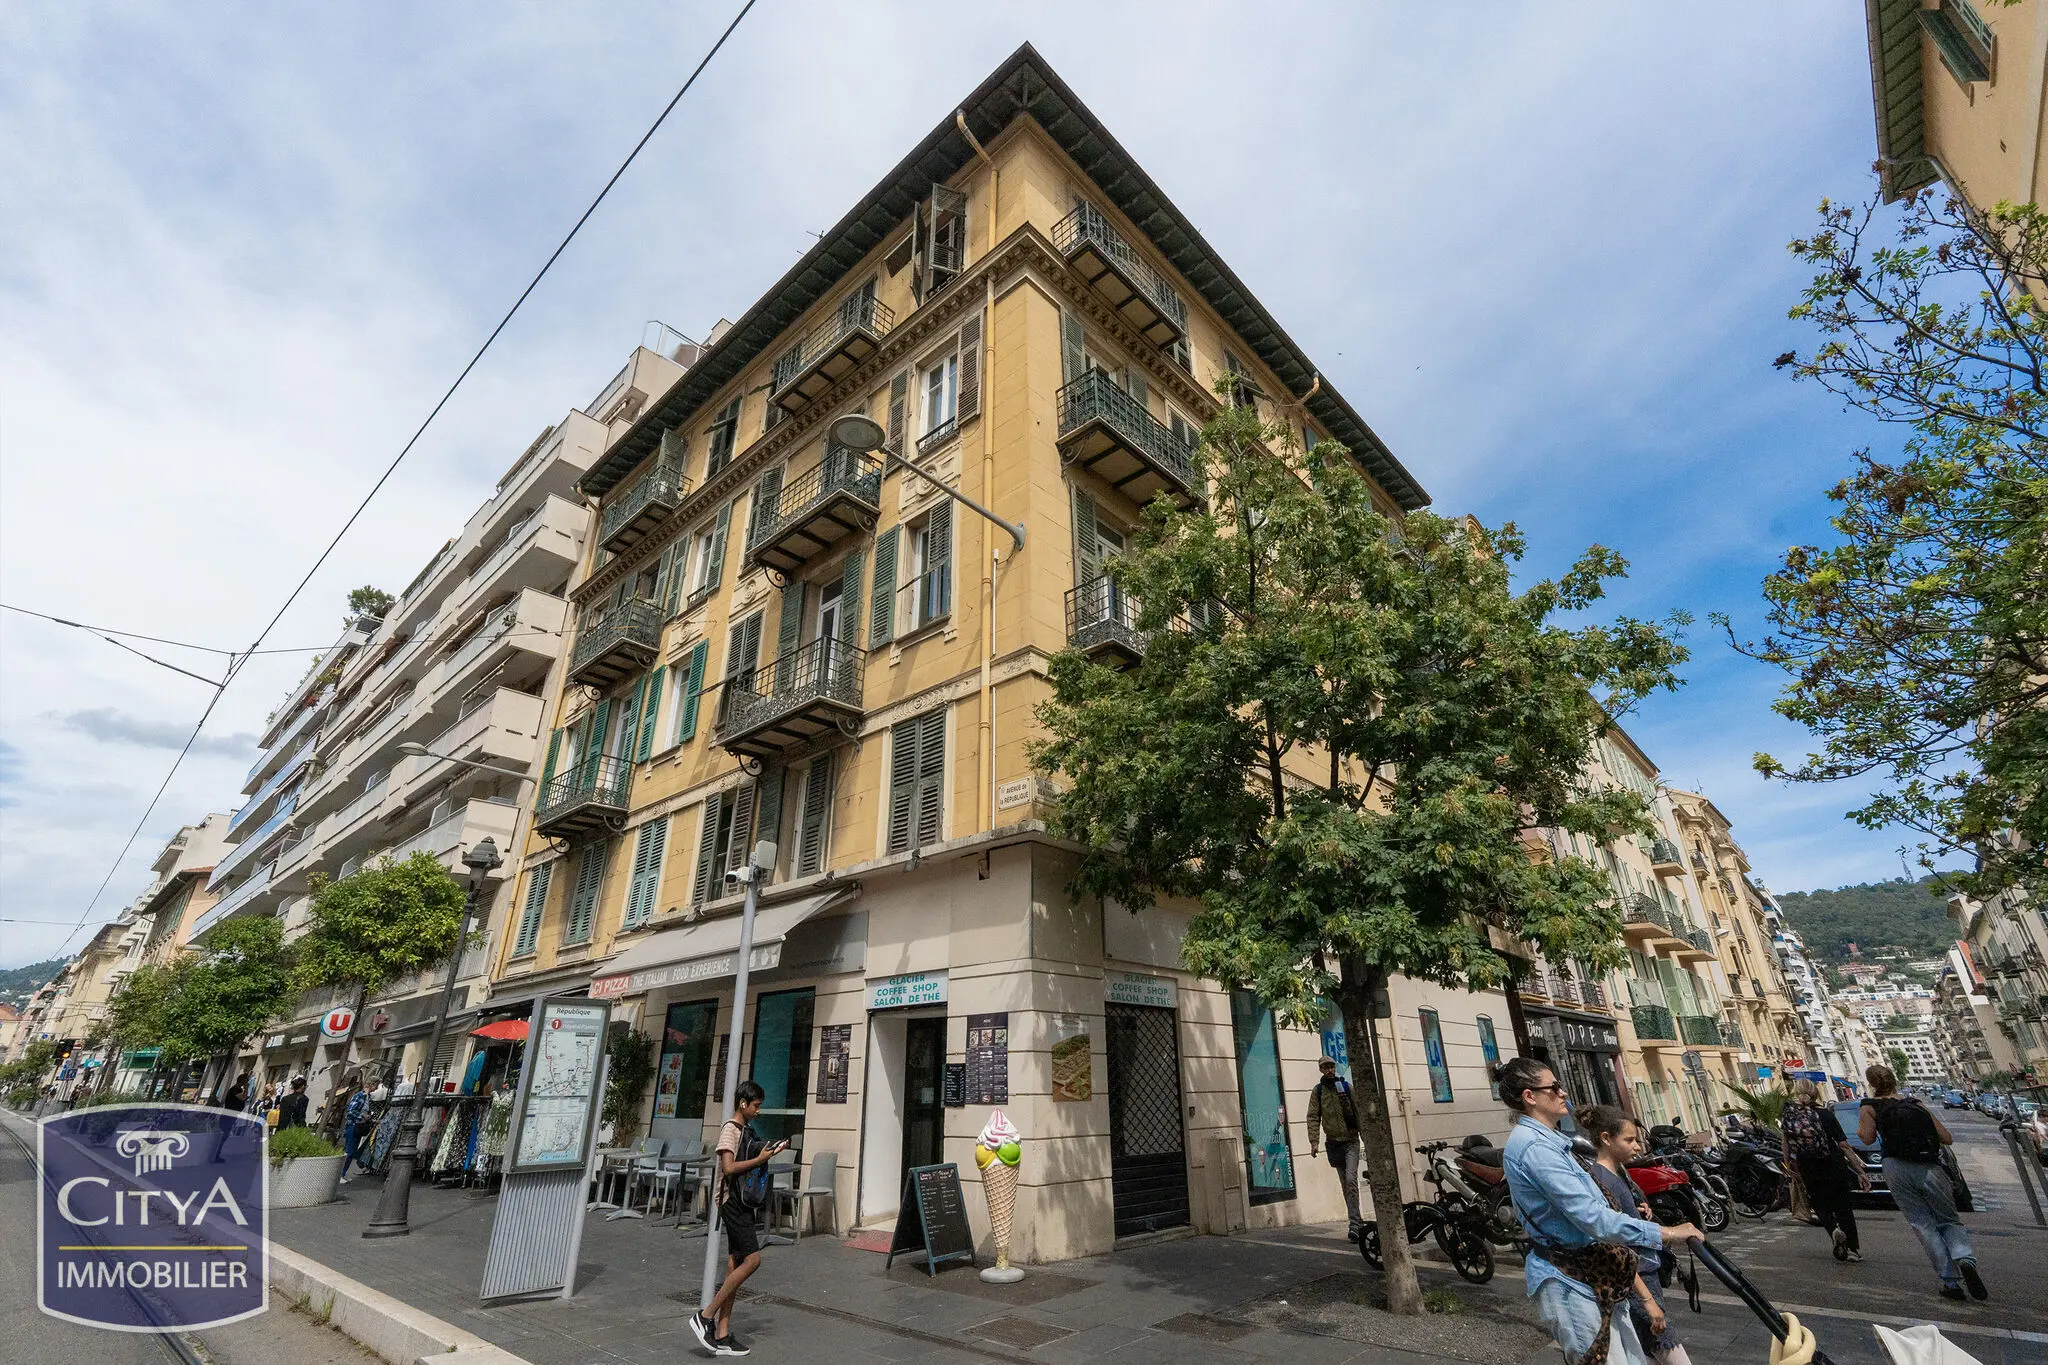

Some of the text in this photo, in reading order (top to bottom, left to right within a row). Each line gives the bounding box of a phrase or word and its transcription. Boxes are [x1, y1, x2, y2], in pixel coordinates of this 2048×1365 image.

[1006, 784, 1021, 794] AVENUE
[604, 976, 629, 993] PIZZA
[632, 974, 644, 988] THE
[645, 970, 668, 986] ITALIAN
[672, 967, 689, 981] FOOD
[690, 958, 731, 978] EXPERIENCE
[889, 974, 926, 985] GLACIER
[1124, 974, 1157, 985] GLACIER
[877, 982, 938, 996] COFFEE SHOP
[1112, 982, 1168, 996] COFFEE SHOP
[874, 996, 903, 1007] SALON
[908, 994, 920, 1003] DE
[1110, 992, 1139, 1003] SALON
[1144, 995, 1154, 1004] DE
[556, 1007, 591, 1016] République
[329, 1013, 352, 1031] U
[1427, 1039, 1442, 1067] LA
